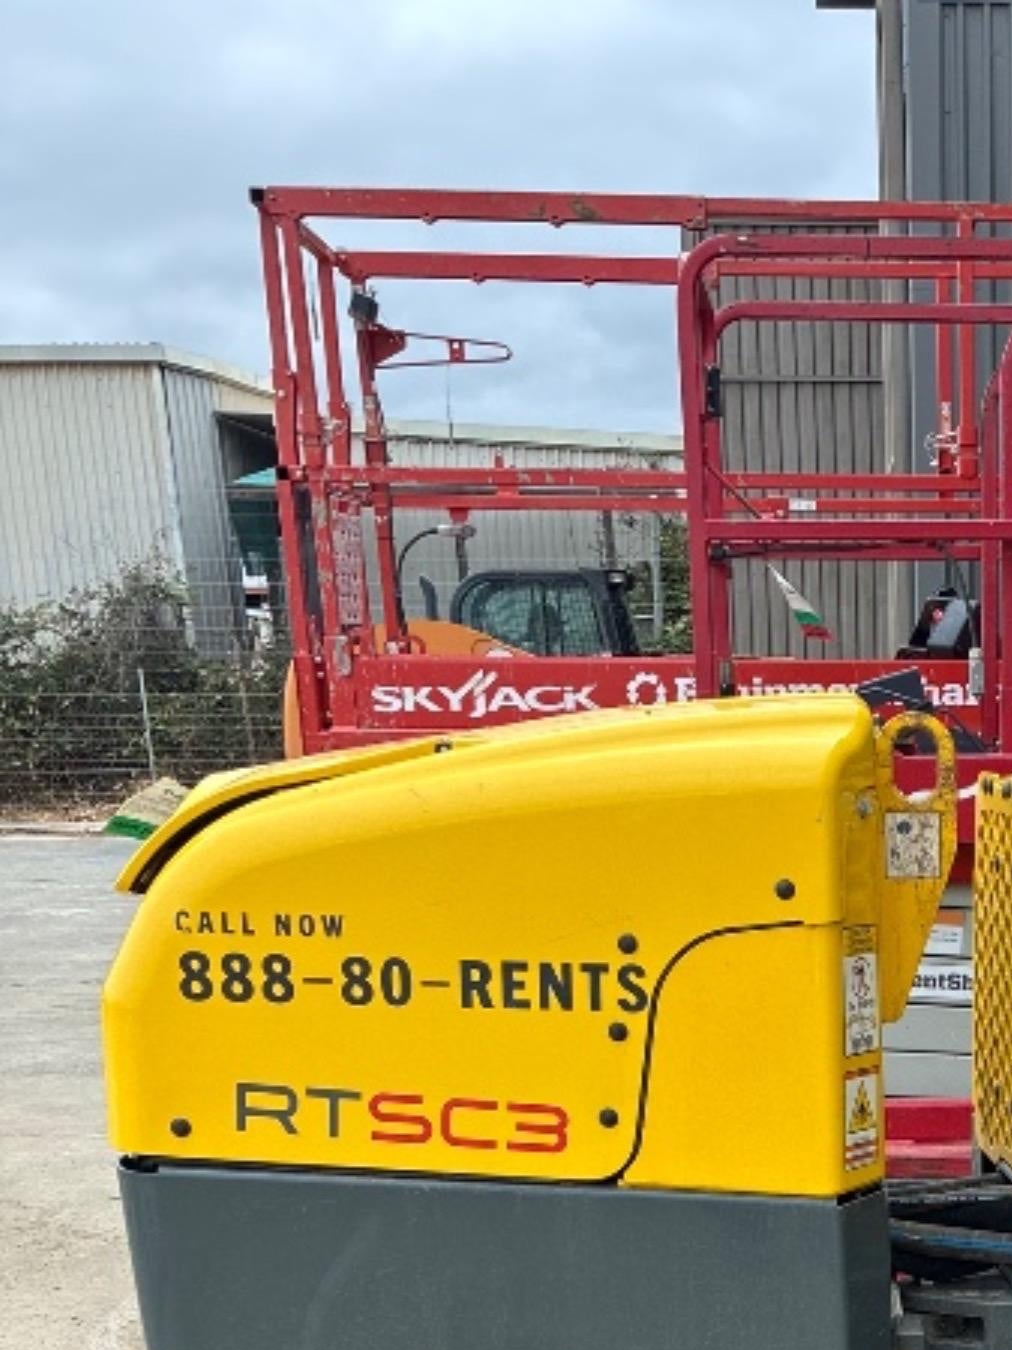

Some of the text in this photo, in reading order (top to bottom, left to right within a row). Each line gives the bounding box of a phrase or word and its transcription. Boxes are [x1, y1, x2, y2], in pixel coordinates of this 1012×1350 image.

[370, 669, 600, 718] SKYJACK
[175, 910, 343, 938] CALL NOW
[179, 951, 650, 1013] 888-80-RENTS
[236, 1082, 569, 1154] RTSC3
